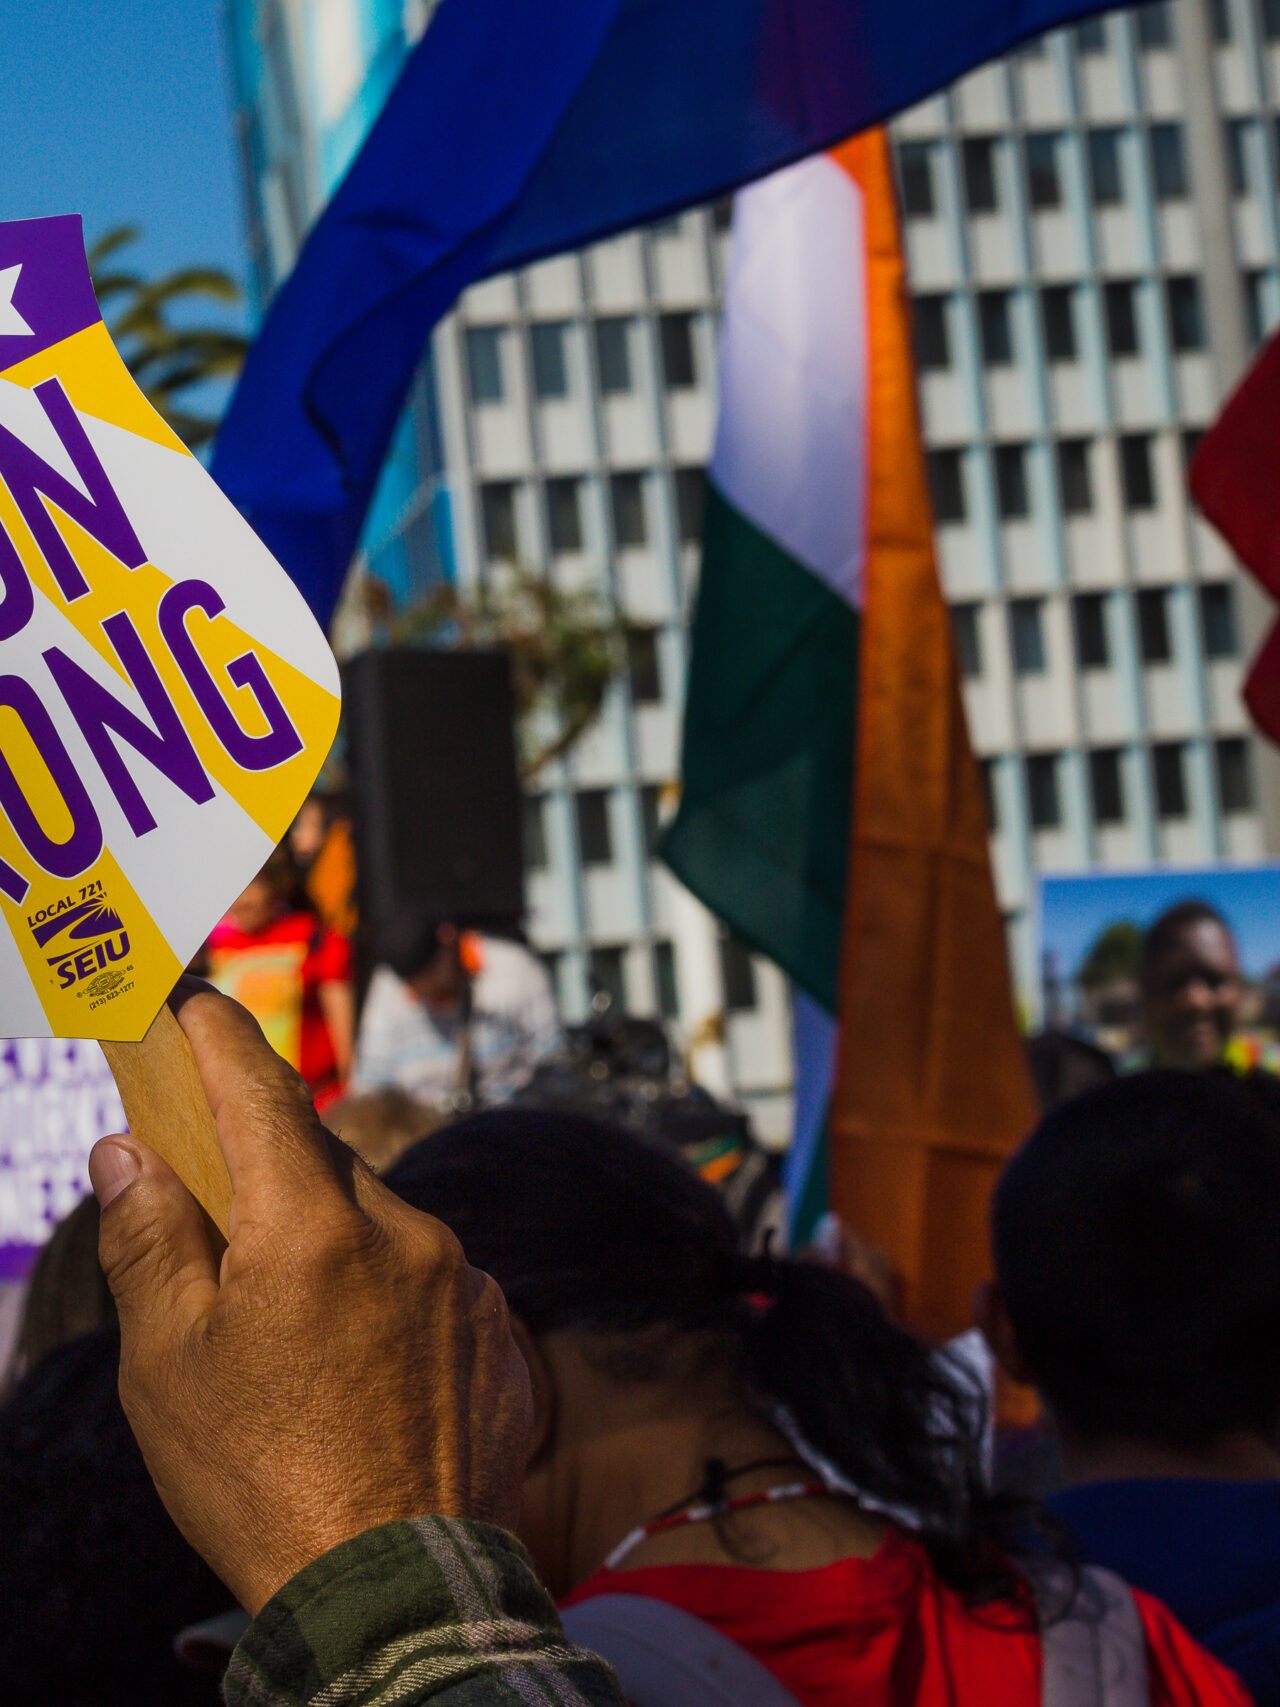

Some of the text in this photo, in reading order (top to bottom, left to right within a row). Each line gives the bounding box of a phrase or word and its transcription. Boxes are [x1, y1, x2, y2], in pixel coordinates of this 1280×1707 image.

[26, 880, 103, 928] LOCAL 721
[57, 931, 130, 989] SEIU
[89, 997, 107, 1011] (213)
